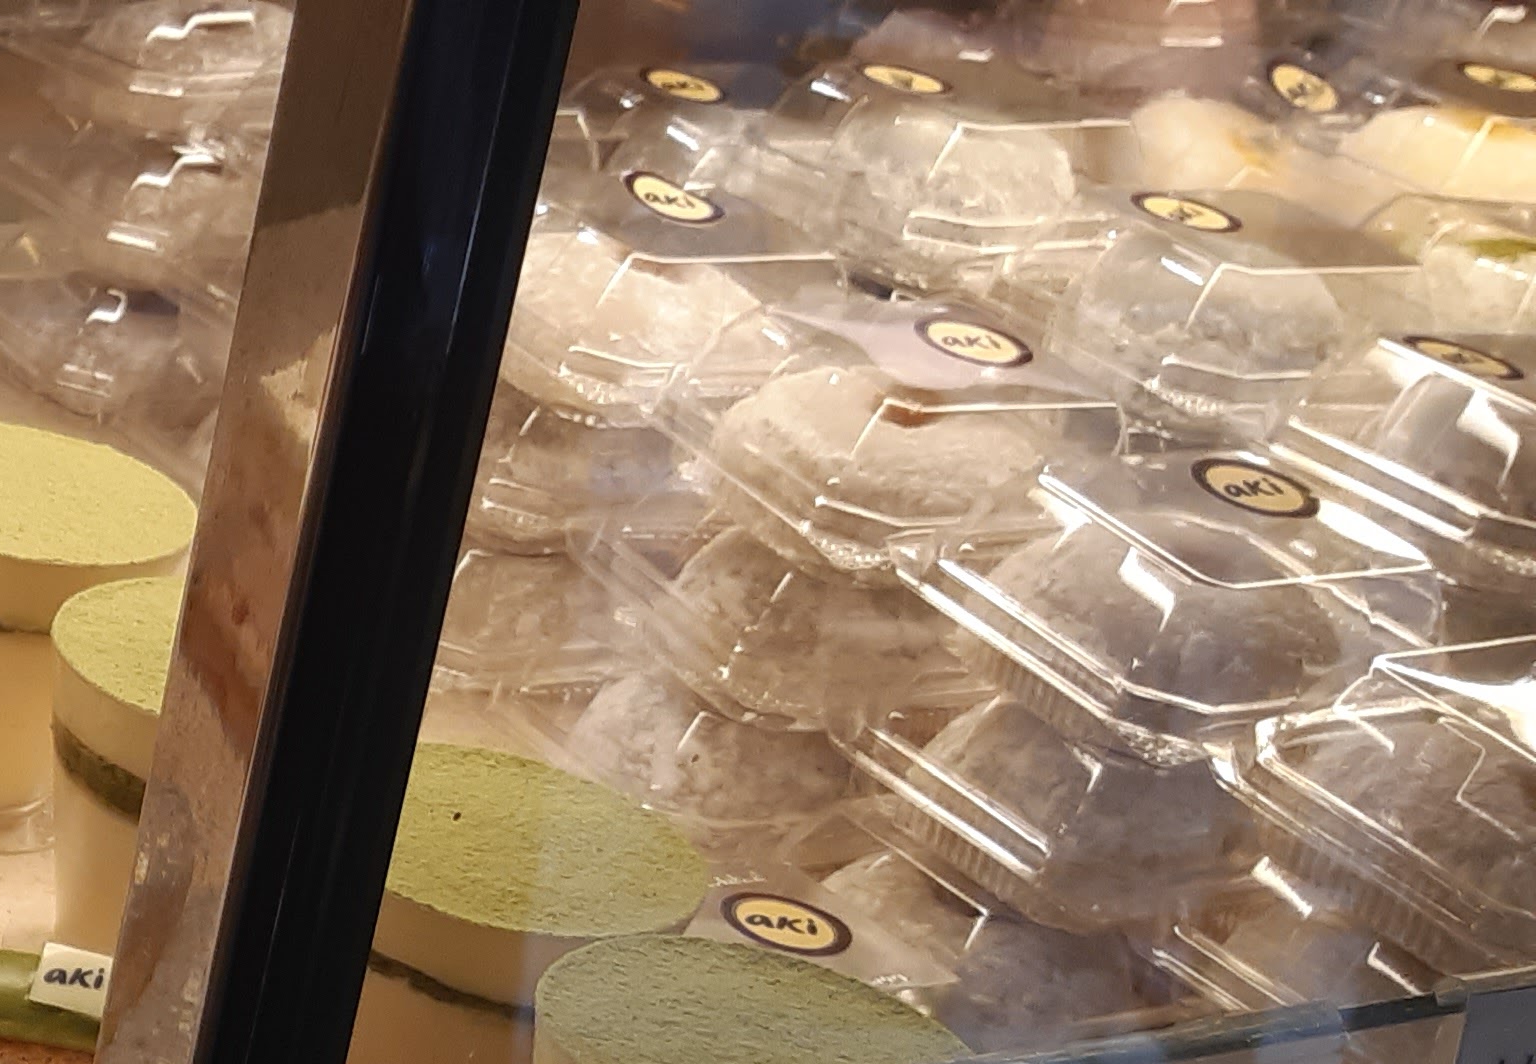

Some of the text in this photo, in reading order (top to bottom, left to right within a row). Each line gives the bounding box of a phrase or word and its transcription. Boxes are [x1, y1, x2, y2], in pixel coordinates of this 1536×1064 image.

[1224, 478, 1284, 497] aki
[745, 915, 817, 935] aki
[44, 968, 104, 990] aki
